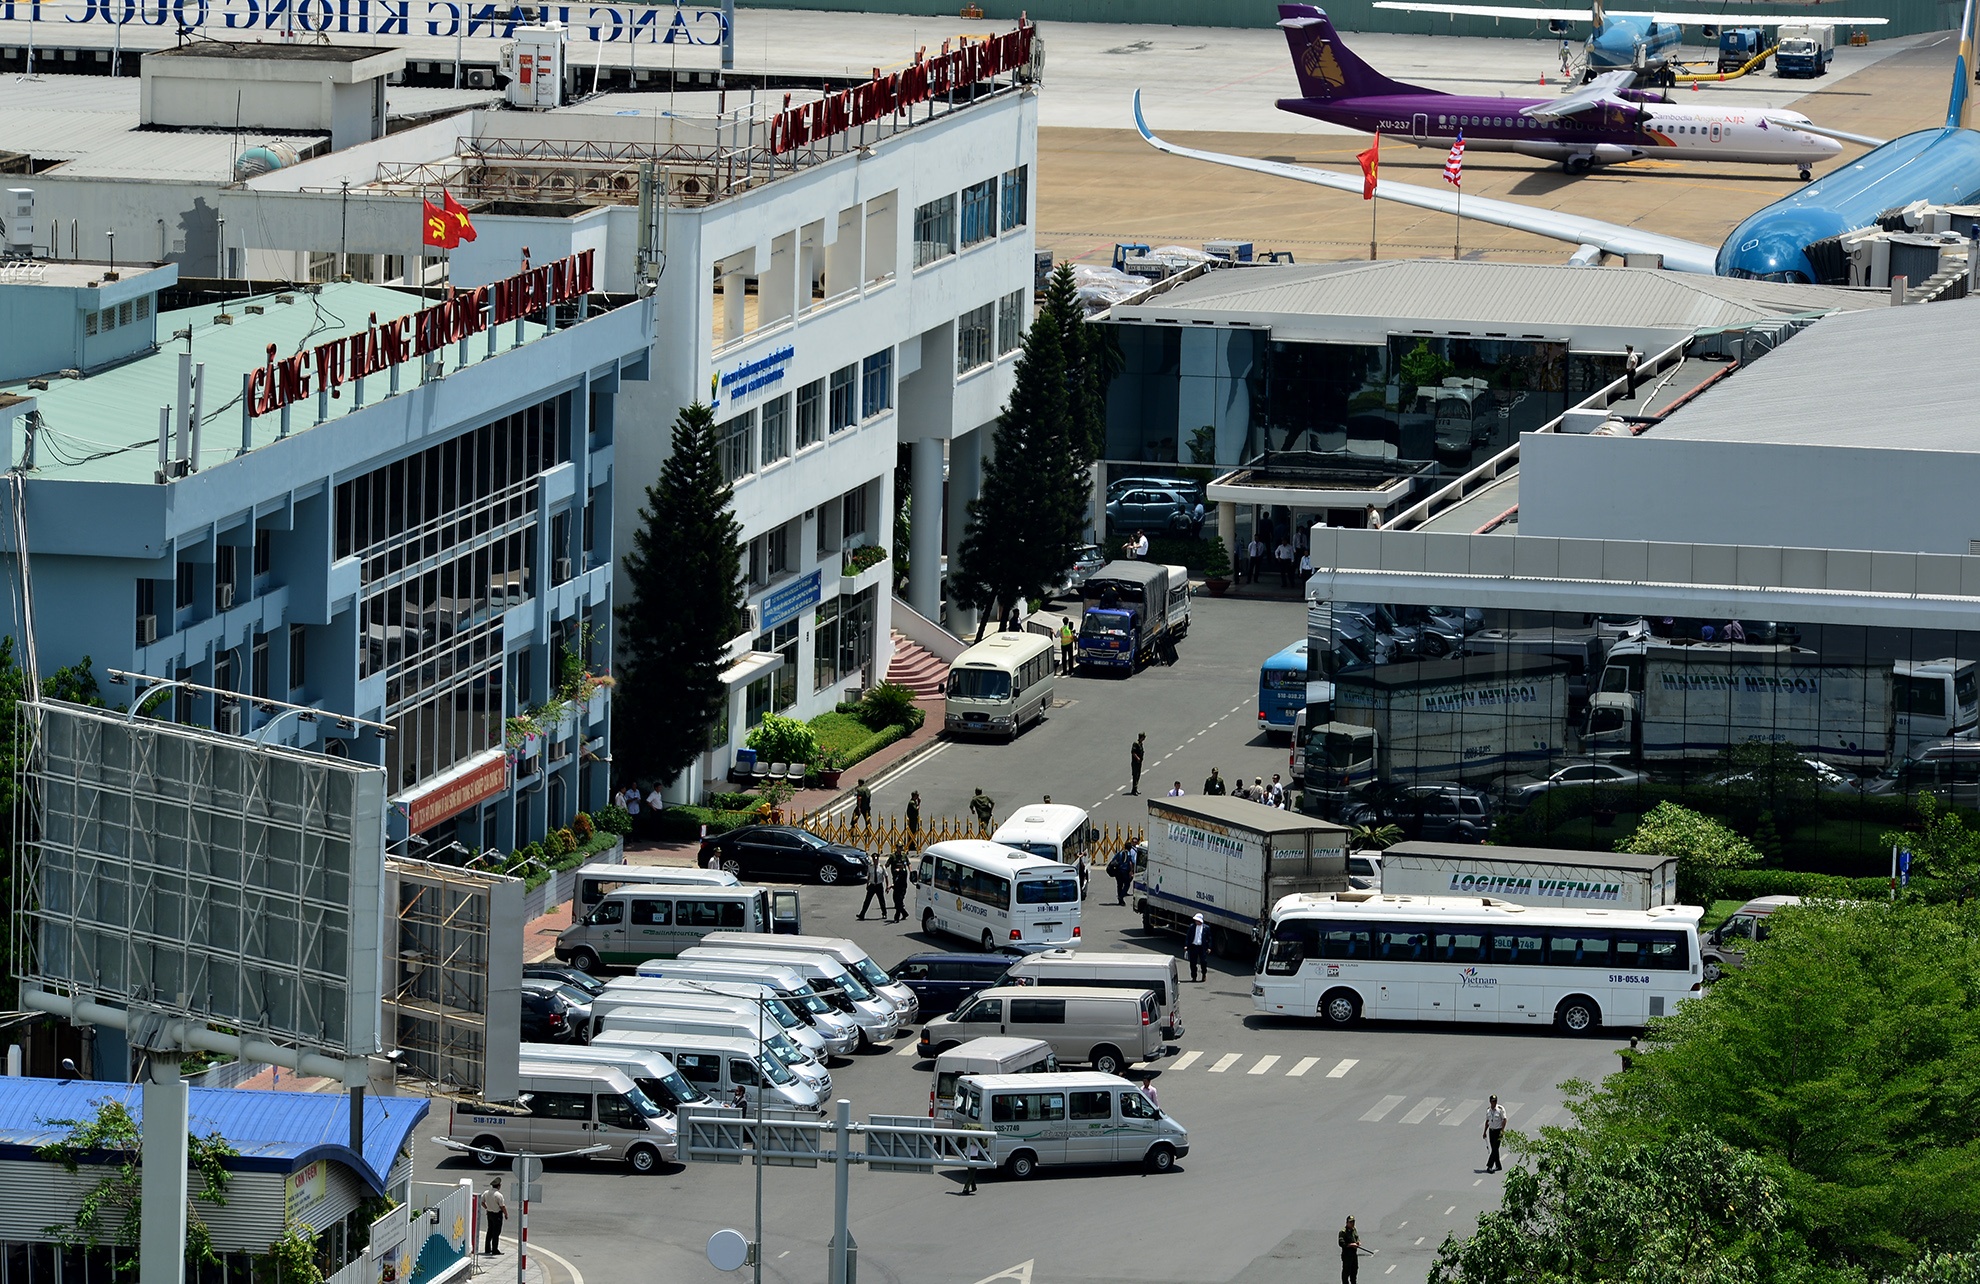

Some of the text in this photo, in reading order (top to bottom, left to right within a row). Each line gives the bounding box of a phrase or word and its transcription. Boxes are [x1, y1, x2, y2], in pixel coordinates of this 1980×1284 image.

[1379, 120, 1410, 129] XU-237
[1651, 112, 1745, 125] Cambodia Angkor AIR
[247, 343, 310, 417] CẢNG
[314, 337, 347, 399] VỤ
[349, 311, 410, 381] HÀNG
[552, 248, 596, 303] NAM
[1168, 824, 1244, 859] LOGITEM VIETNAM
[1274, 849, 1341, 858] LOGITEM VIETNAM
[1450, 874, 1621, 900] LOGITEM VIETNAM
[1459, 973, 1498, 988] Vietnam
[1609, 974, 1650, 984] 51B-055.48
